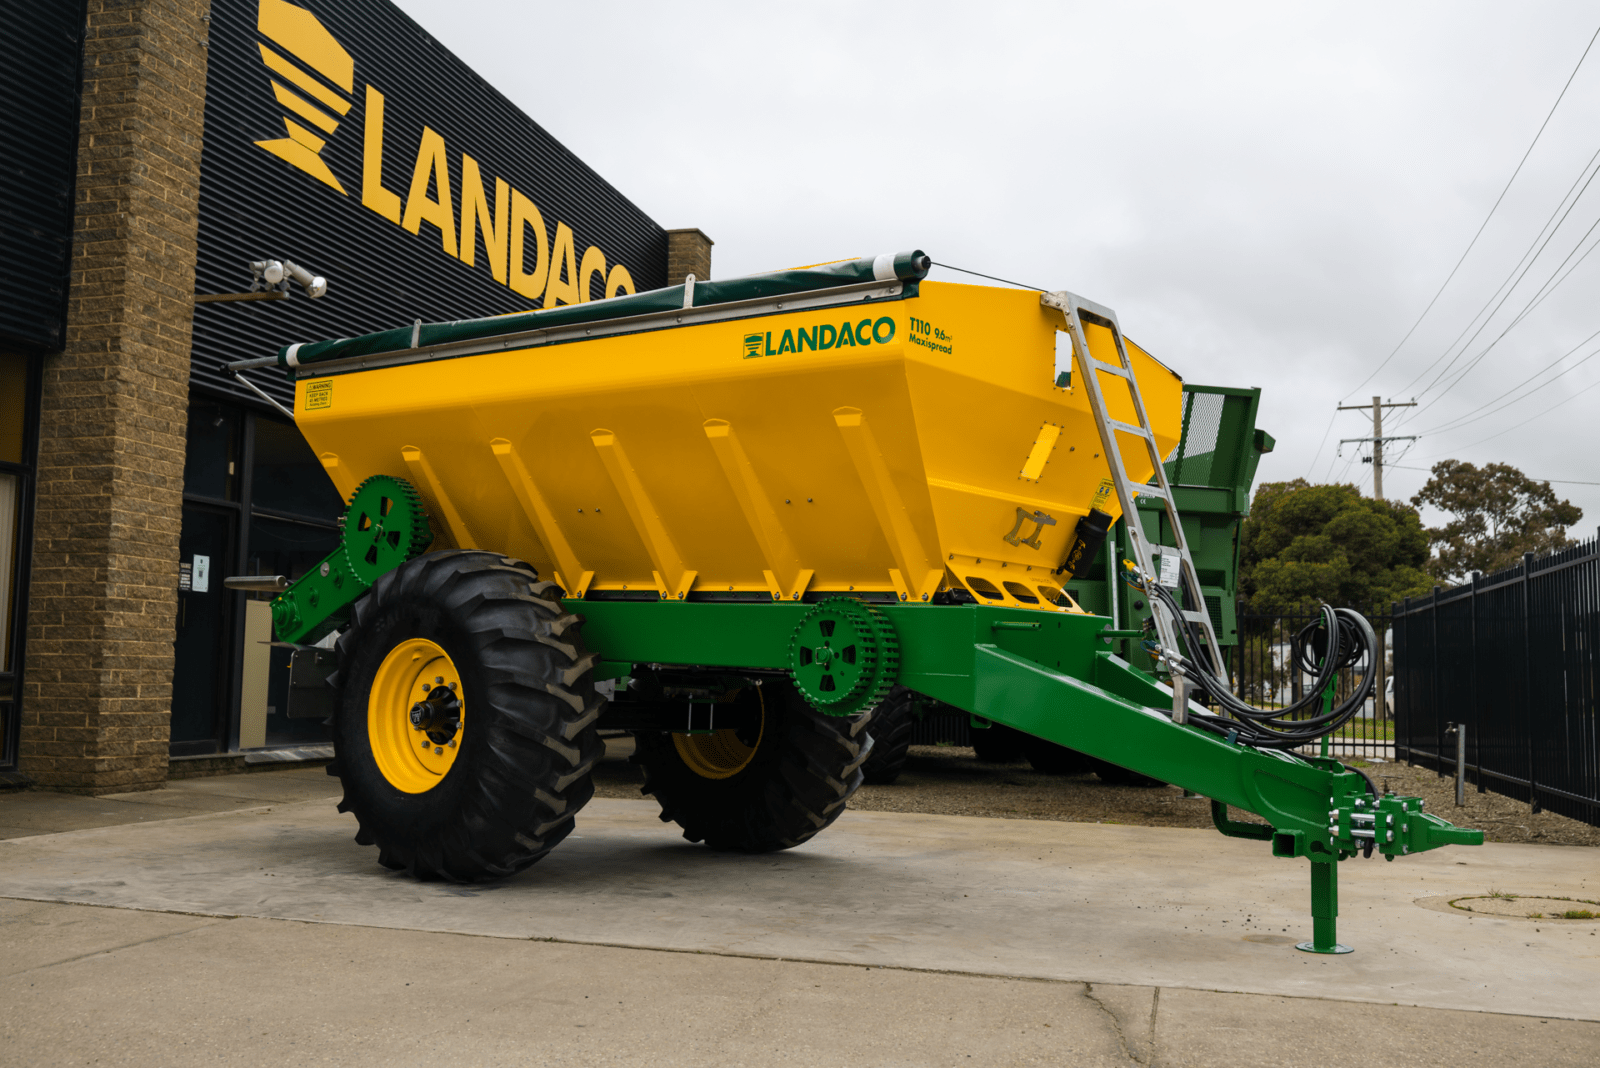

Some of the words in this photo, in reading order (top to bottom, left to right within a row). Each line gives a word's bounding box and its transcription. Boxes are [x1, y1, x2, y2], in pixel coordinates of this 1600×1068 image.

[764, 316, 896, 357] LANDACO
[909, 316, 931, 336] T110
[908, 333, 953, 355] Maxispread
